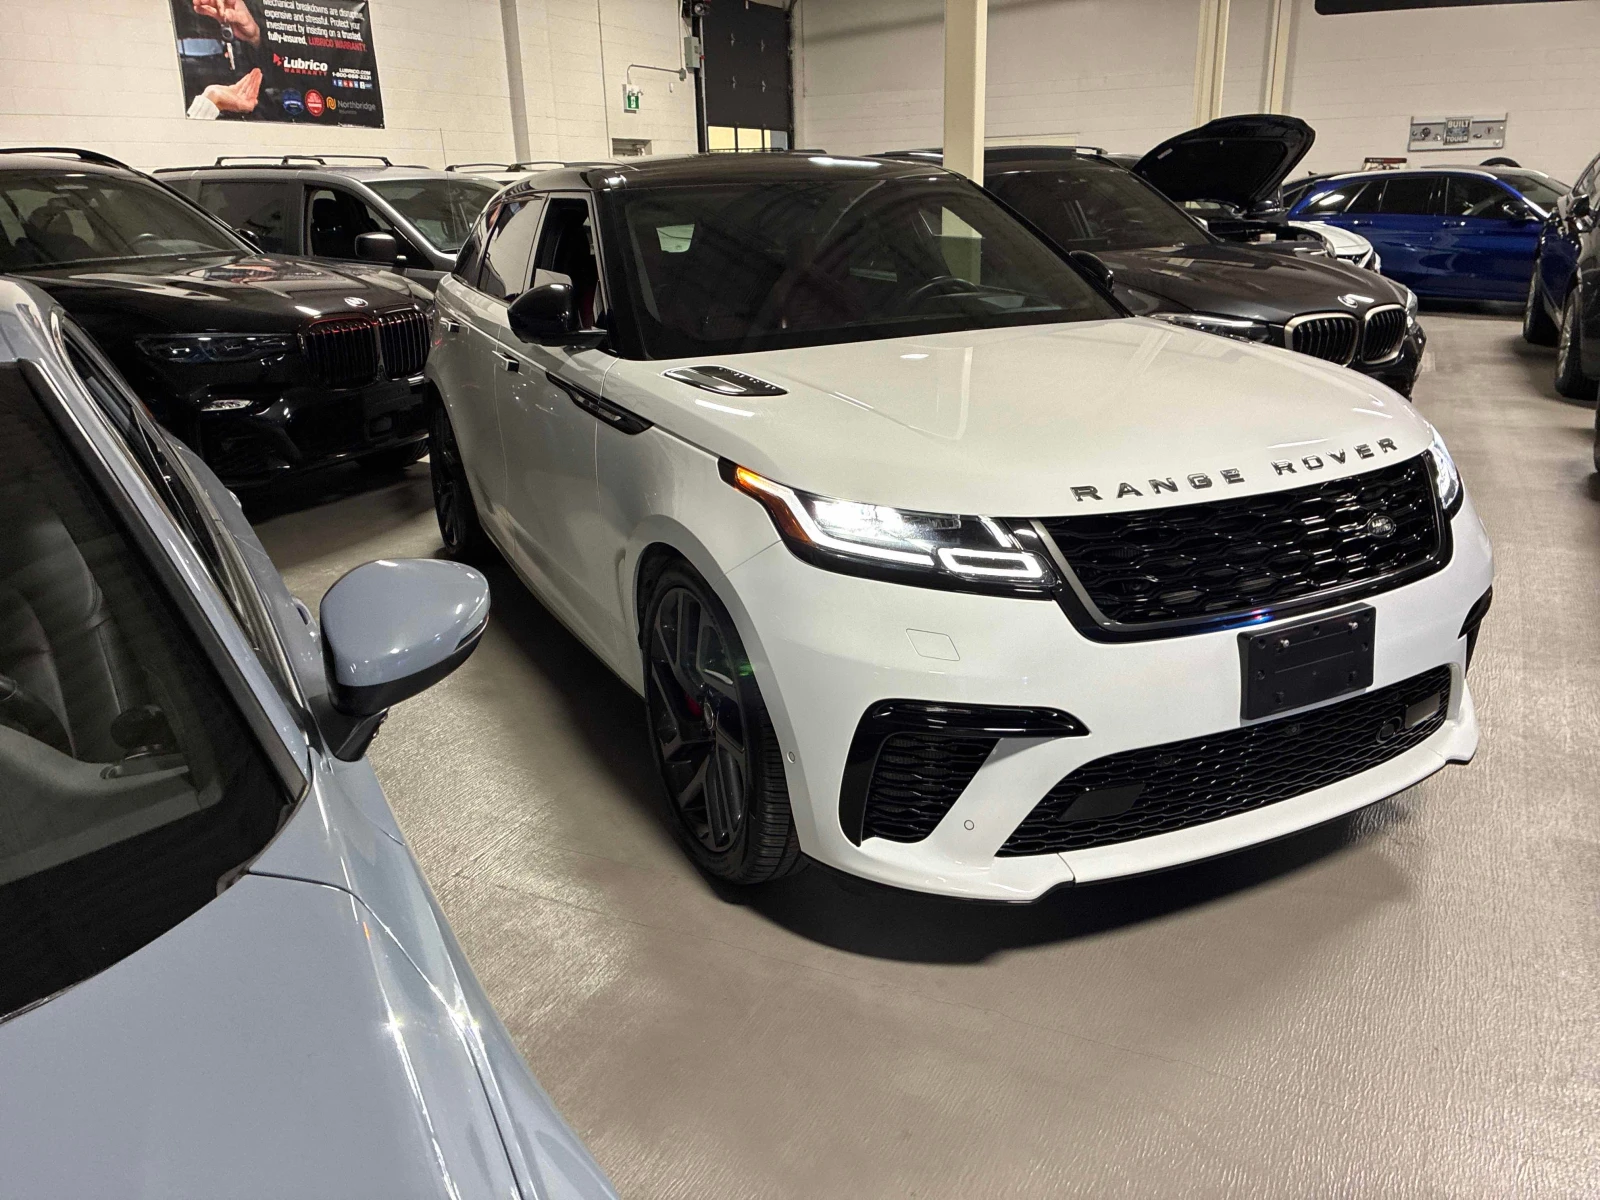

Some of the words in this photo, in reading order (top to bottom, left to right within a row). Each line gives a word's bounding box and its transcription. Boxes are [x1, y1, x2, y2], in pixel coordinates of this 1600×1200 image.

[296, 1, 328, 14] breakdowns
[329, 8, 338, 16] are
[264, 9, 293, 20] expensive
[293, 13, 305, 22] and
[330, 17, 350, 28] Protect
[350, 22, 360, 31] your
[266, 19, 298, 32] investment
[298, 23, 305, 35] by
[306, 24, 328, 38] insisting
[329, 29, 336, 38] on
[337, 30, 341, 38] a
[308, 36, 334, 48] LUBRICO
[284, 56, 328, 71] Lubrico
[284, 67, 328, 76] WARRANTY
[337, 100, 376, 111] Northbridge
[1448, 120, 1469, 128] BUILT
[1070, 468, 1245, 502] RANGE
[1271, 438, 1398, 475] ROVER
